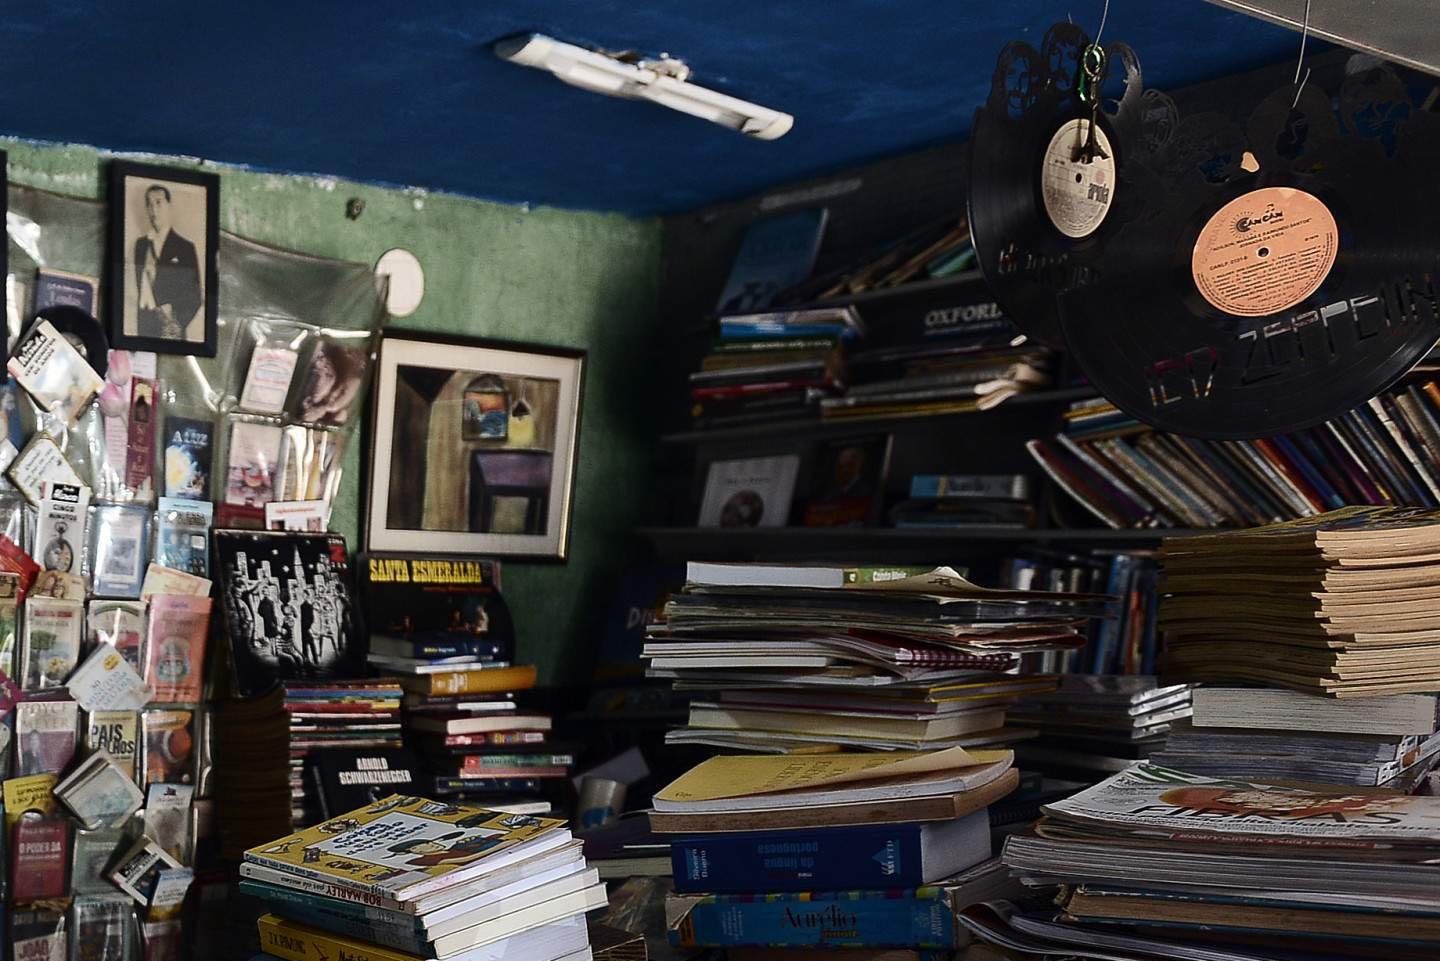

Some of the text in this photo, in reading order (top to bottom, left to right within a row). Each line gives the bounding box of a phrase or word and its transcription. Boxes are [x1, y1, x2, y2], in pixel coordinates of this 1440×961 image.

[52, 503, 75, 514] CINCO
[368, 558, 483, 583] SANTA ESMERALDA
[91, 724, 123, 742] PAIS
[332, 823, 392, 845] Coisas
[26, 842, 49, 854] PODER
[323, 882, 383, 907] BOB MARLEY
[781, 905, 858, 930] Aurélio
